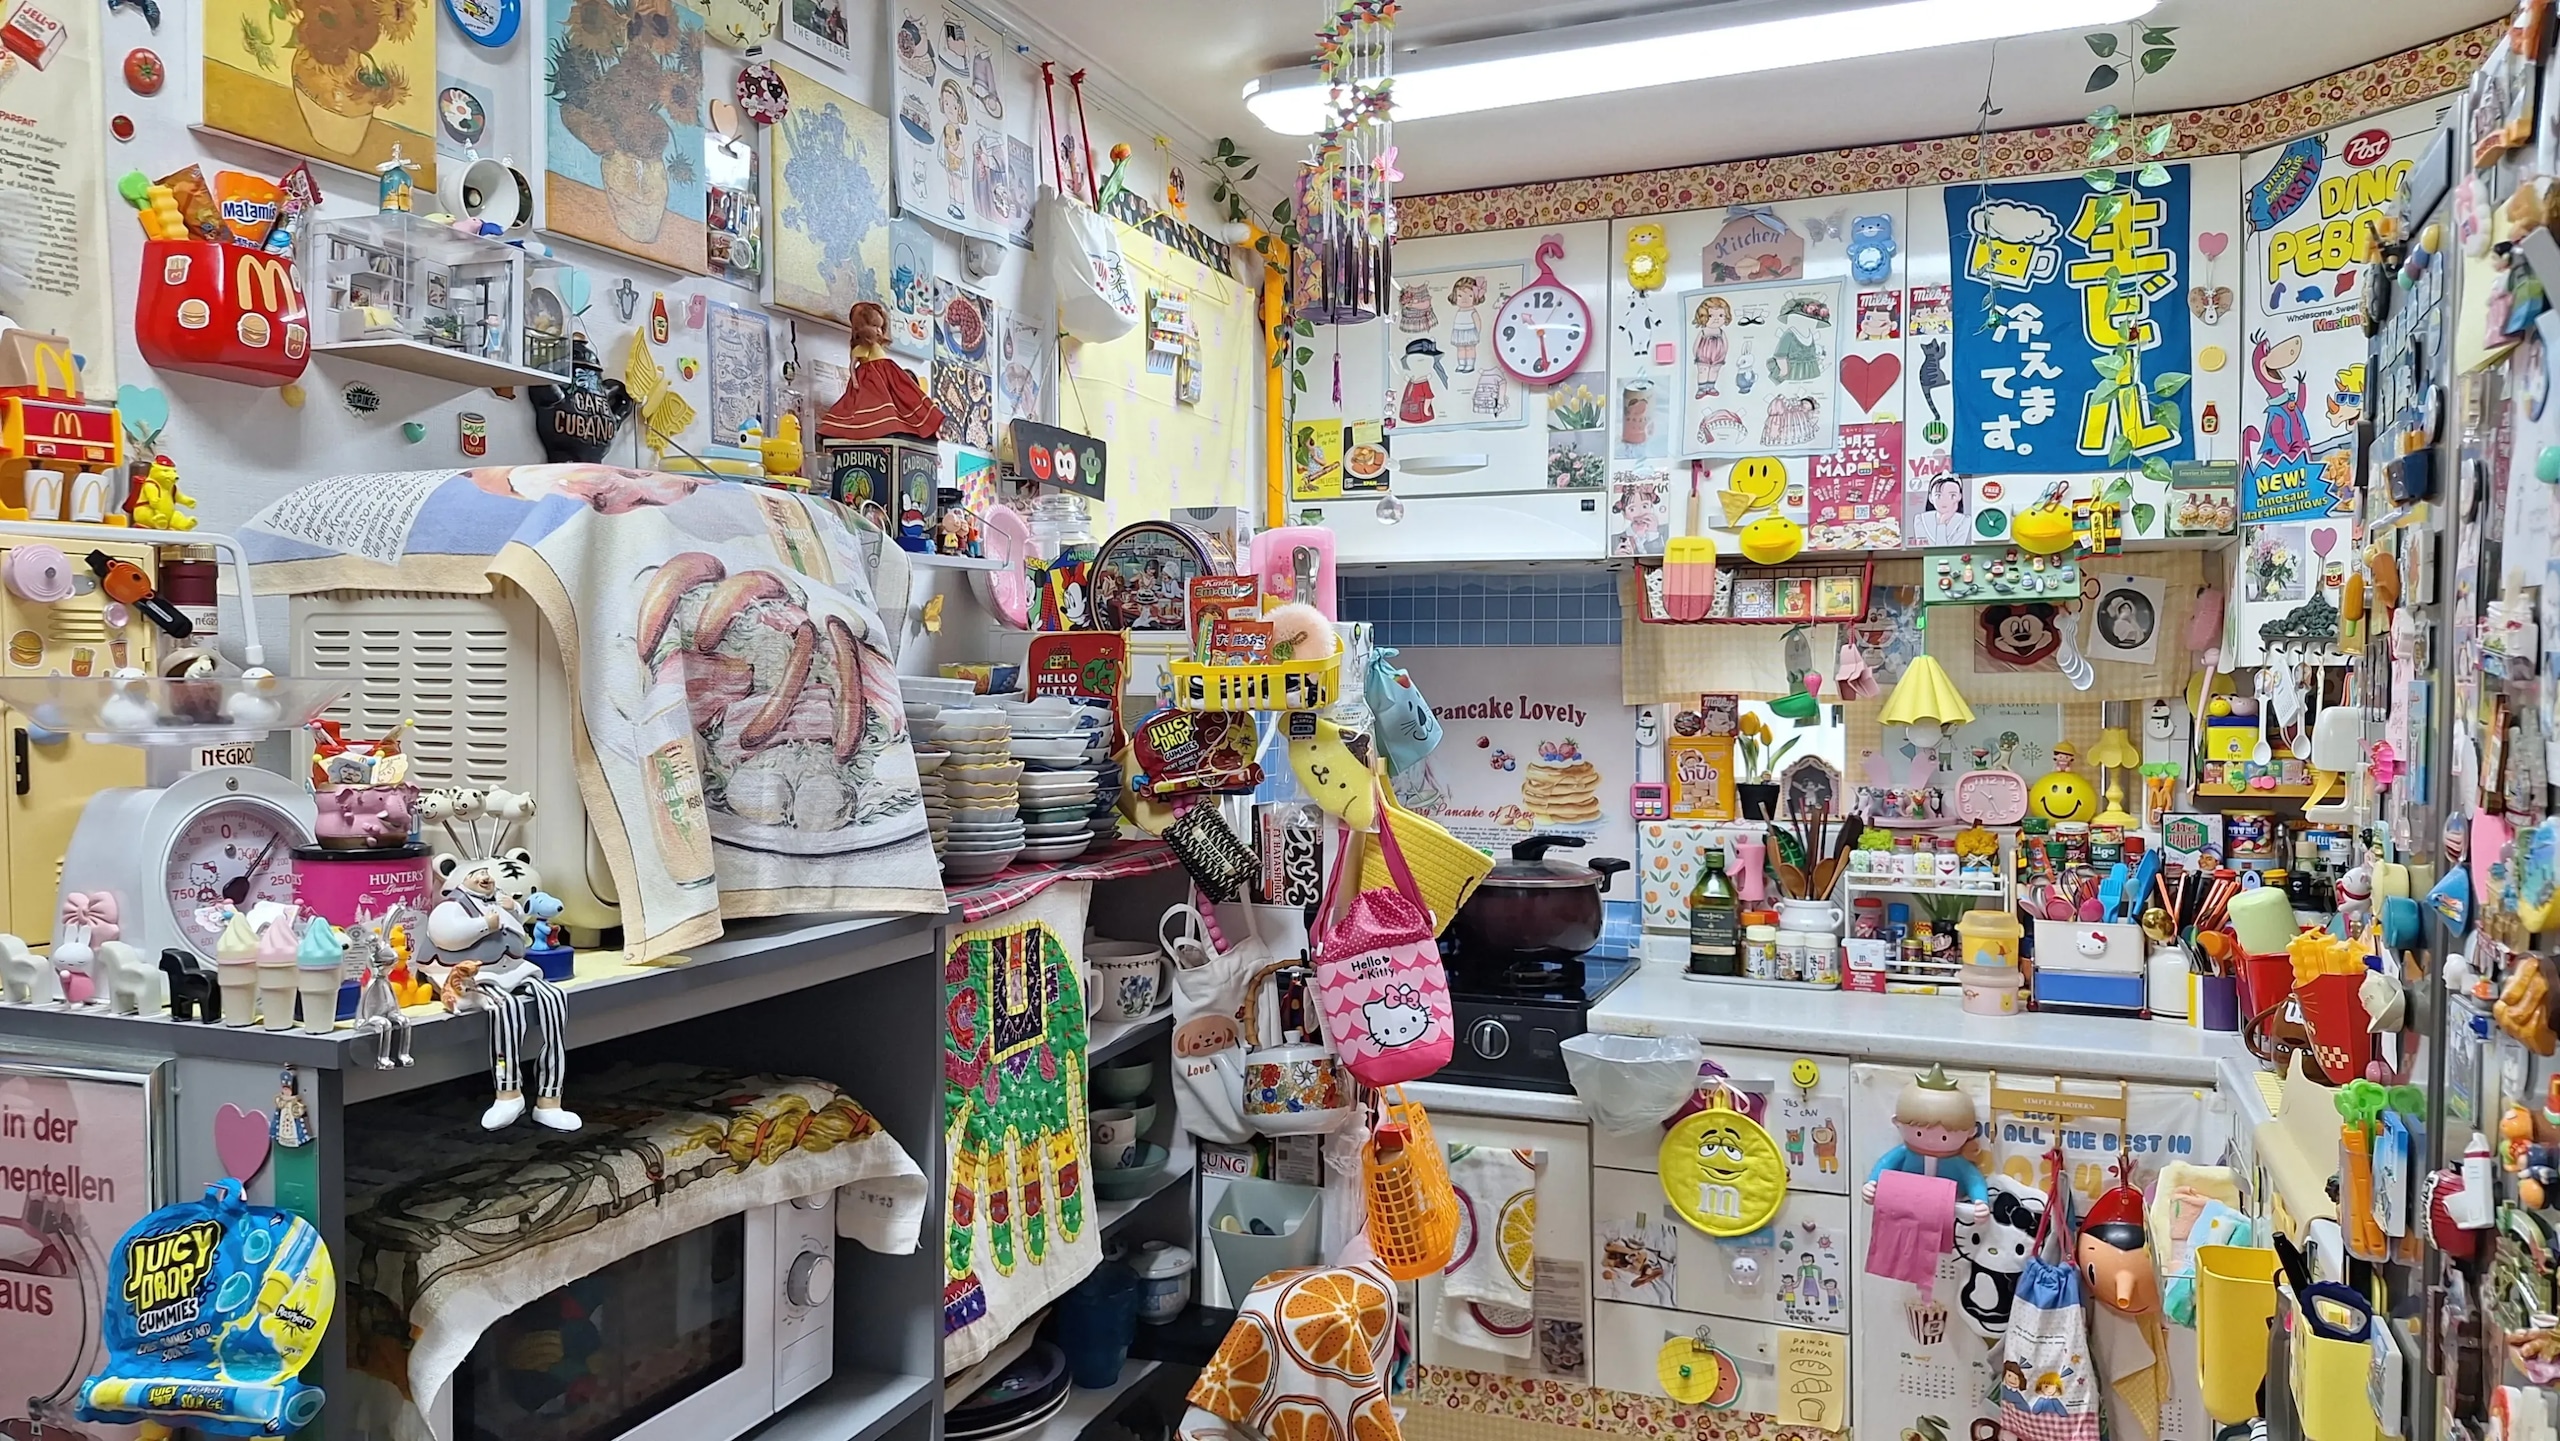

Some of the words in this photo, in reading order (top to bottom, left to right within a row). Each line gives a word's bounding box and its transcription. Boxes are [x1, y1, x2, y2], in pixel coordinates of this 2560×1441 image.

[793, 24, 810, 41] THE
[816, 35, 852, 62] BRIDGE
[2346, 136, 2388, 161] Post
[2264, 154, 2305, 206] DINOSAUR
[2268, 154, 2321, 223] PARTY
[222, 201, 277, 221] Matamis
[1714, 226, 1783, 259] Kitchen
[1532, 291, 1554, 309] 12
[1859, 294, 1898, 311] Milky
[1912, 288, 1951, 305] Milky
[1502, 325, 1516, 342] 9
[1568, 323, 1580, 340] 3
[575, 391, 611, 415] CAFE
[554, 410, 615, 444] CUBANO
[834, 451, 888, 475] ADBURY'S
[902, 454, 937, 482] CADBURY'S
[1815, 462, 1857, 478] MAP
[2255, 467, 2307, 497] NEW!
[2256, 488, 2310, 508] Dinosaur
[2242, 496, 2329, 521] Marshmallows
[1201, 578, 1238, 588] Kinder
[1037, 672, 1078, 684] HELLO
[1036, 685, 1078, 697] KITTY
[1431, 695, 1514, 721] Pancake
[1519, 695, 1588, 728] Lovely
[1149, 714, 1195, 747] JUICY
[1160, 727, 1192, 752] DROP
[1163, 740, 1199, 761] GUMMIES
[1962, 782, 1976, 793] 10
[2008, 780, 2018, 791] 2
[1434, 802, 1485, 819] Pancake
[1488, 806, 1500, 822] of
[1504, 803, 1536, 820] Love
[220, 823, 232, 839] 0
[1200, 837, 1230, 873] BOHOL
[2092, 846, 2116, 859] Ligo
[270, 873, 292, 887] 250
[369, 869, 426, 886] HUNTER'S
[171, 888, 196, 901] 750
[382, 883, 418, 897] Gourmet
[1273, 884, 1282, 906] RICE
[1350, 956, 1382, 973] Hello
[1366, 966, 1396, 980] Kitty
[1186, 1063, 1211, 1077] Love
[1782, 1098, 1799, 1108] YES
[1799, 1108, 1819, 1117] CAN
[2023, 1096, 2055, 1108] SIMPLE
[2061, 1100, 2096, 1111] MODERN
[4, 1108, 29, 1138] in
[33, 1107, 78, 1144] der
[2003, 1122, 2046, 1146] ALL
[2052, 1130, 2097, 1151] THE
[2102, 1132, 2163, 1154] BEST
[2167, 1133, 2193, 1155] IN
[129, 1226, 214, 1292] JUICY
[140, 1263, 196, 1311] DROP
[138, 1299, 200, 1336] GUMMIES
[275, 1304, 317, 1330] Raspberry
[1792, 1337, 1816, 1345] PAIN
[1789, 1345, 1833, 1358] MÉNAGE
[149, 1384, 179, 1402] JUICY
